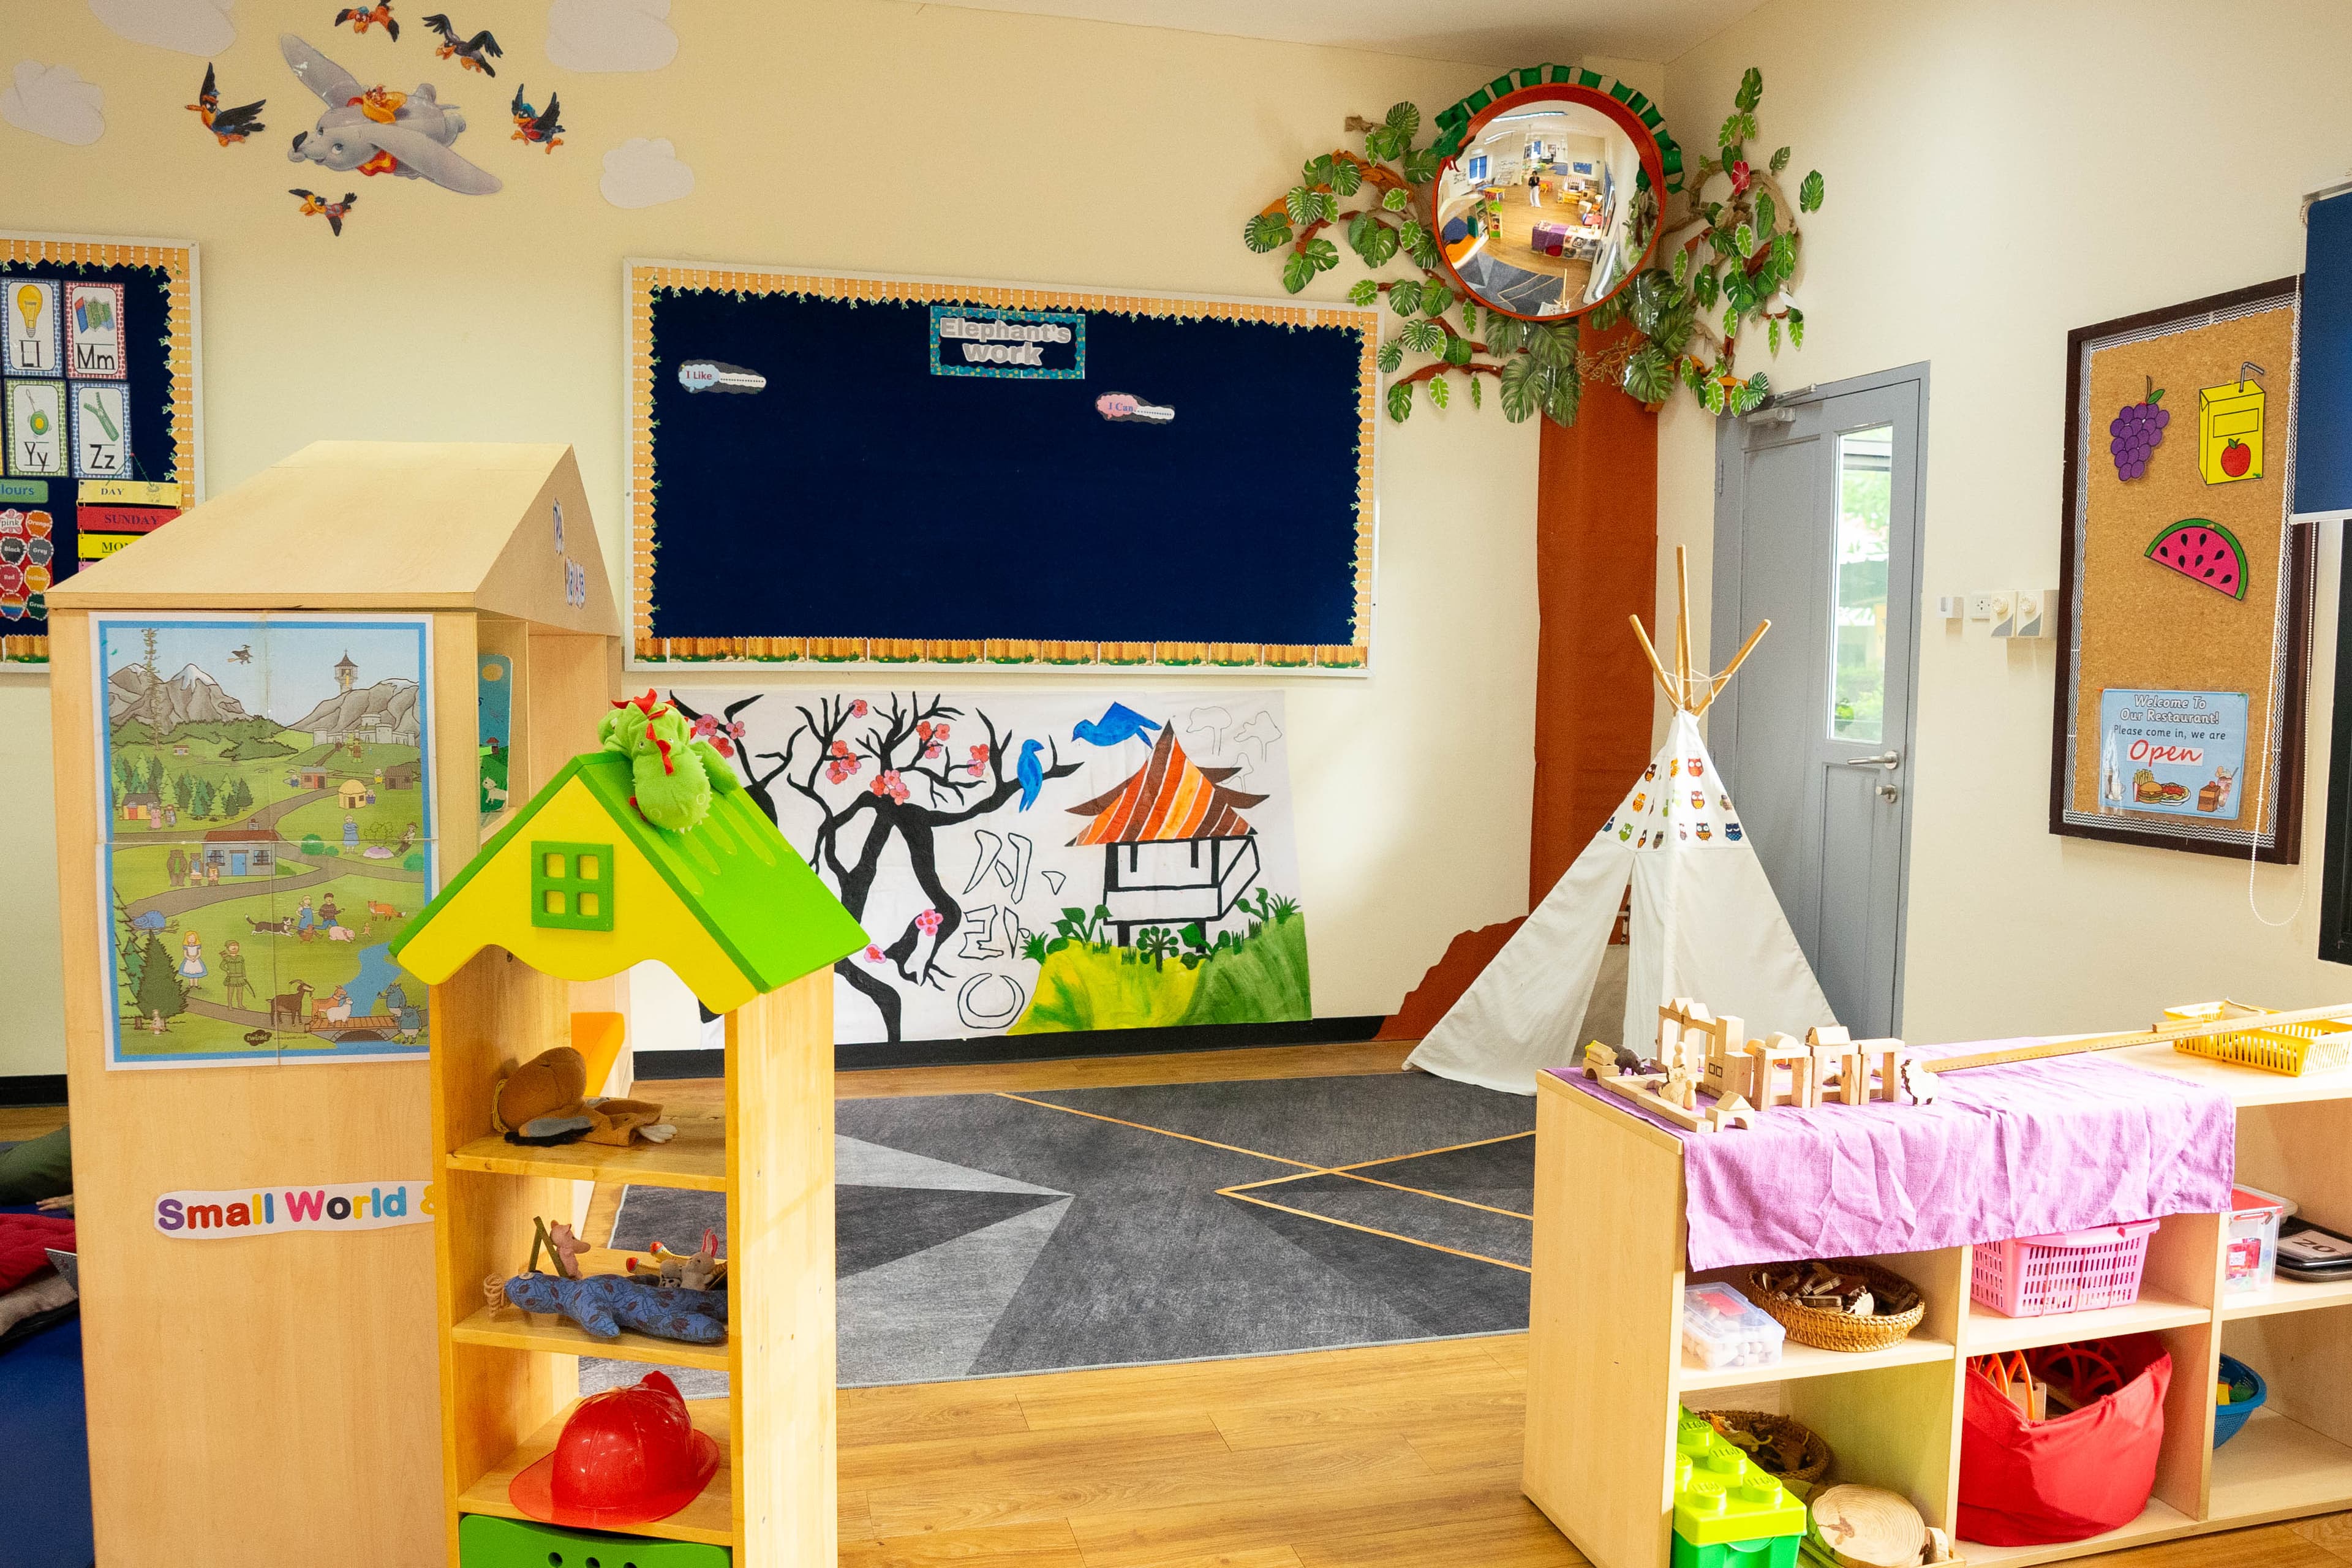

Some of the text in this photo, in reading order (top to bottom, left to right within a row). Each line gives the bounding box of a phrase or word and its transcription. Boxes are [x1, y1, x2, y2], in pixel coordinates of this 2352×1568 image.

[941, 318, 1070, 342] Elephant's
[77, 344, 115, 369] Mm
[693, 371, 712, 380] Like
[1115, 402, 1133, 412] Can
[24, 442, 48, 472] Yy
[90, 444, 115, 469] Zz
[1, 519, 20, 527] pink
[104, 514, 157, 525] SUNDAY
[2135, 695, 2206, 709] Welcome To
[2120, 709, 2219, 724] Our Restaurant!
[2114, 725, 2142, 736] Please
[2175, 728, 2187, 739] in,
[2130, 739, 2202, 767] Open
[158, 1193, 274, 1231] Small
[285, 1186, 407, 1222] World
